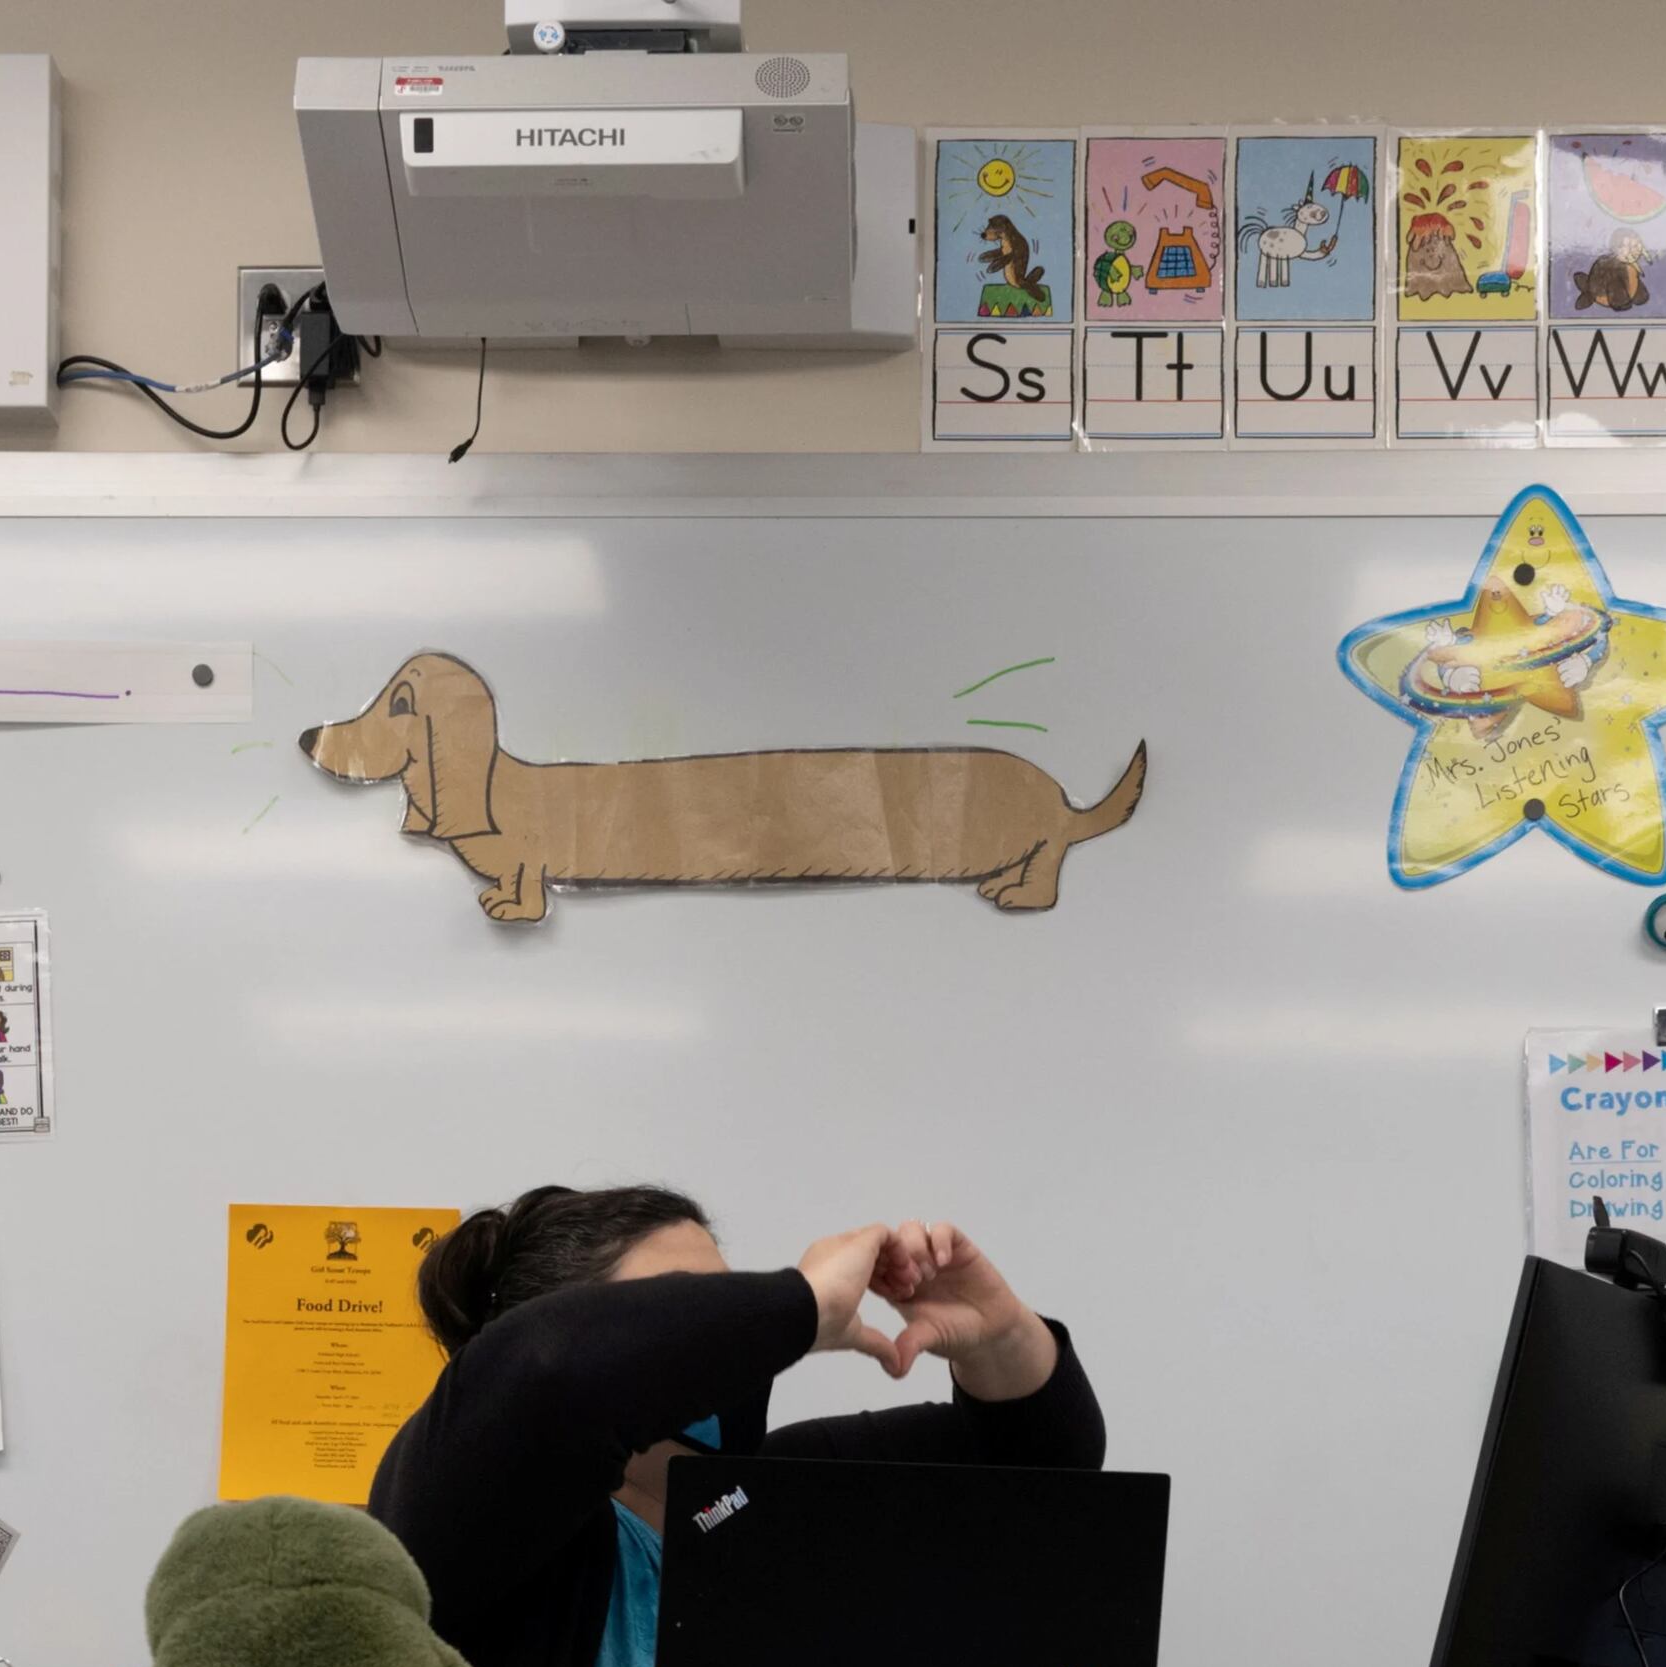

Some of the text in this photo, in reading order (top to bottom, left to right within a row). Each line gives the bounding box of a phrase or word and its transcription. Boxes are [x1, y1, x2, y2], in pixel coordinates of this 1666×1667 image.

[516, 128, 625, 148] HITACHI
[959, 332, 1045, 402] Ss
[1112, 332, 1194, 401] Tt
[1259, 329, 1356, 399] Uu
[1427, 329, 1511, 398] Vv
[1425, 716, 1562, 787] Mrs. Jones'
[1475, 745, 1596, 809] Listening
[1558, 782, 1630, 819] Stars
[1569, 1140, 1659, 1160] Are For
[1569, 1171, 1663, 1191] Coloring
[297, 1298, 383, 1313] Food Drive!
[693, 1485, 750, 1534] ThinkPad
